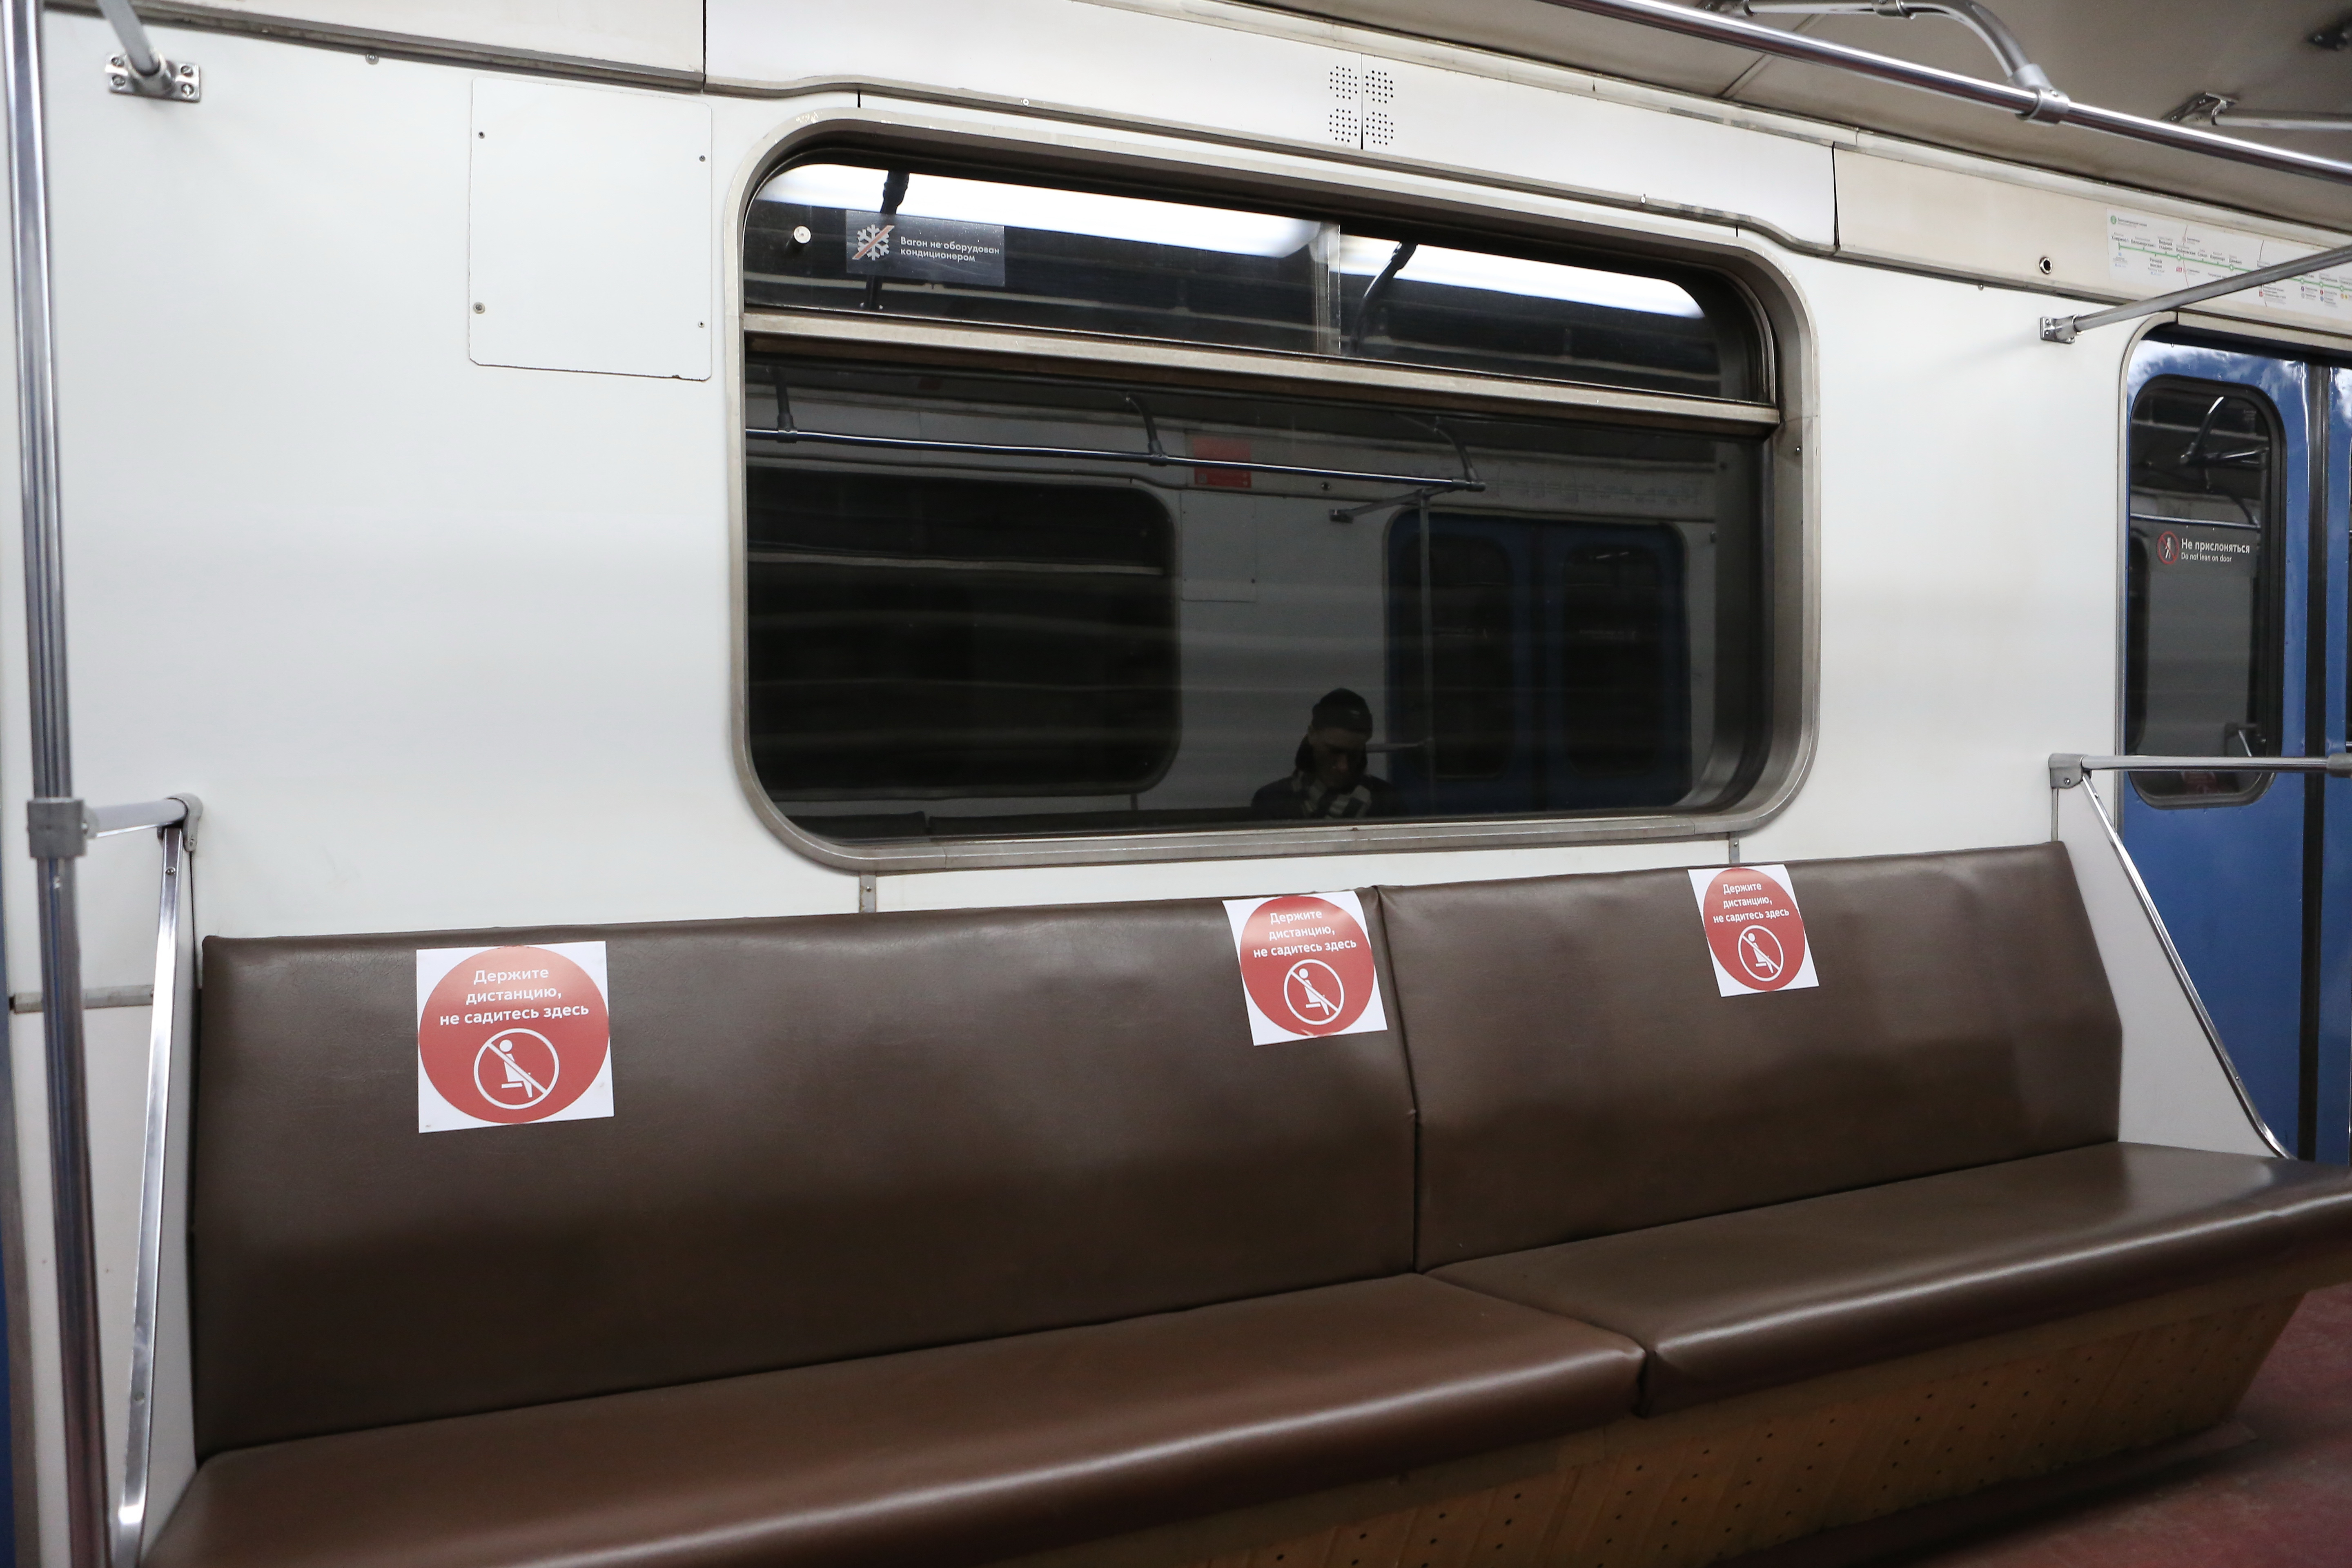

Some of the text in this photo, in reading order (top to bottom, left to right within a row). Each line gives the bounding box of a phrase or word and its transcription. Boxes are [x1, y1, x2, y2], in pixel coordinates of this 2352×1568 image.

[901, 236, 928, 247] Вагон
[944, 241, 1000, 254] оборудован
[901, 248, 976, 263] кондиционером
[2182, 538, 2250, 553] Не прислоняться
[2220, 554, 2232, 563] door
[1723, 882, 1762, 895] Держите
[1723, 896, 1773, 909] дистанцию,
[1270, 911, 1322, 924] Держите
[1713, 908, 1790, 923] не садитесь здесь
[1269, 925, 1335, 941] дистанцию,
[1253, 939, 1357, 958] не садитесь здесь
[473, 969, 549, 985] Держите
[466, 987, 561, 1005] дистанцию,
[440, 1004, 589, 1026] не садитесь здесь
